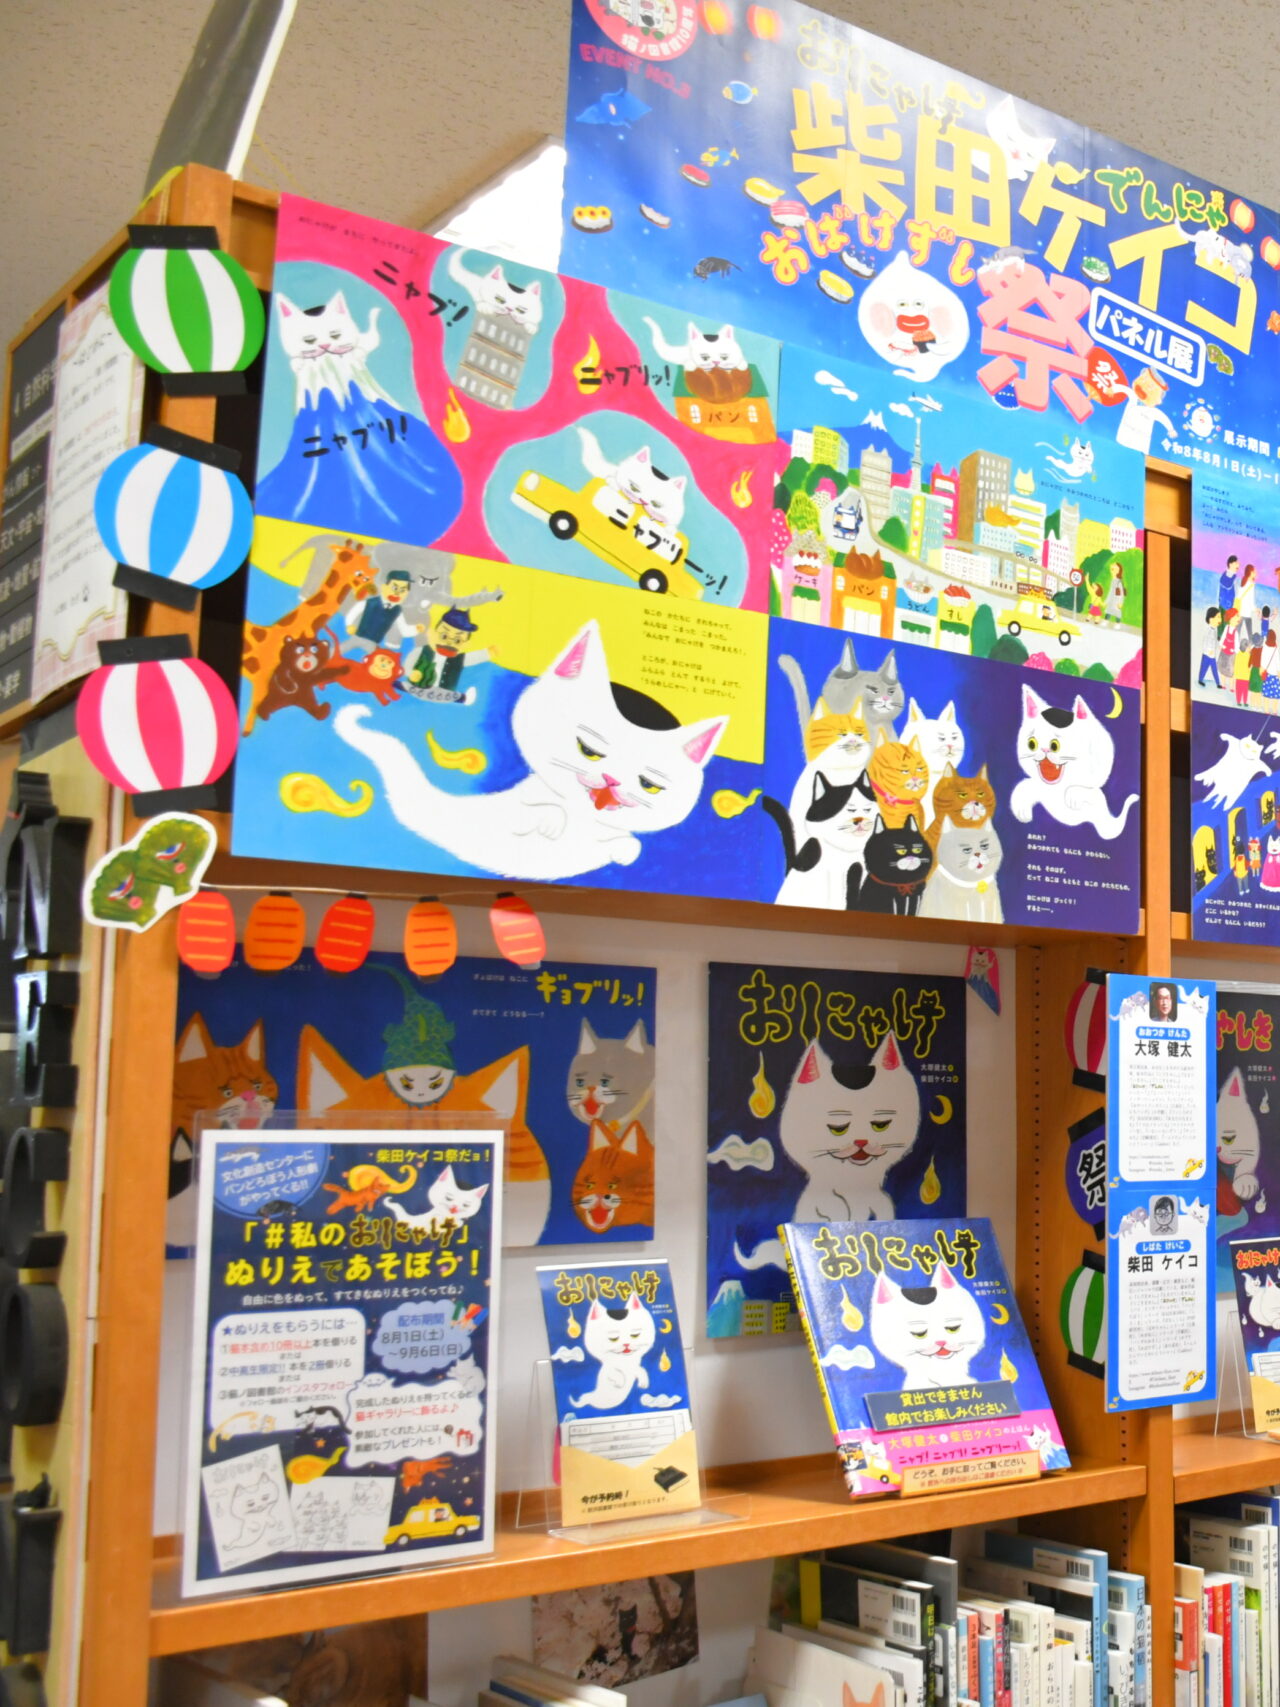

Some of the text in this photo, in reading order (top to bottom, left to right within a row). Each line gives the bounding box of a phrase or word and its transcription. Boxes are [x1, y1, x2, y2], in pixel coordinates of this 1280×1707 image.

[759, 204, 976, 287] おばけずし
[976, 262, 1098, 423] 祭
[1096, 304, 1197, 375] パネル展
[706, 409, 741, 425] パン
[1222, 429, 1270, 457] 展示期間
[793, 574, 818, 588] ケーキ
[852, 584, 874, 597] パン
[906, 601, 930, 614] うどん
[947, 608, 963, 621] すし
[536, 971, 645, 1007] ギョブリッ!
[738, 968, 946, 1059] おにゃけ
[1138, 1028, 1187, 1038] おおつか けんた
[1134, 1040, 1192, 1058] 大塚 健太
[812, 1226, 982, 1281] おにゃけ
[1142, 1241, 1184, 1252] しばた けいこ
[224, 1249, 480, 1286] ぬりえであそぼう!
[1127, 1254, 1198, 1273] 柴田 ケイコ
[555, 1270, 660, 1305] おにゃけ
[397, 1313, 445, 1327] 配布期間
[381, 1330, 445, 1344] 8月1日(土)
[899, 1387, 983, 1407] 貸出できません
[885, 1402, 1007, 1427] 館内でお楽しみください
